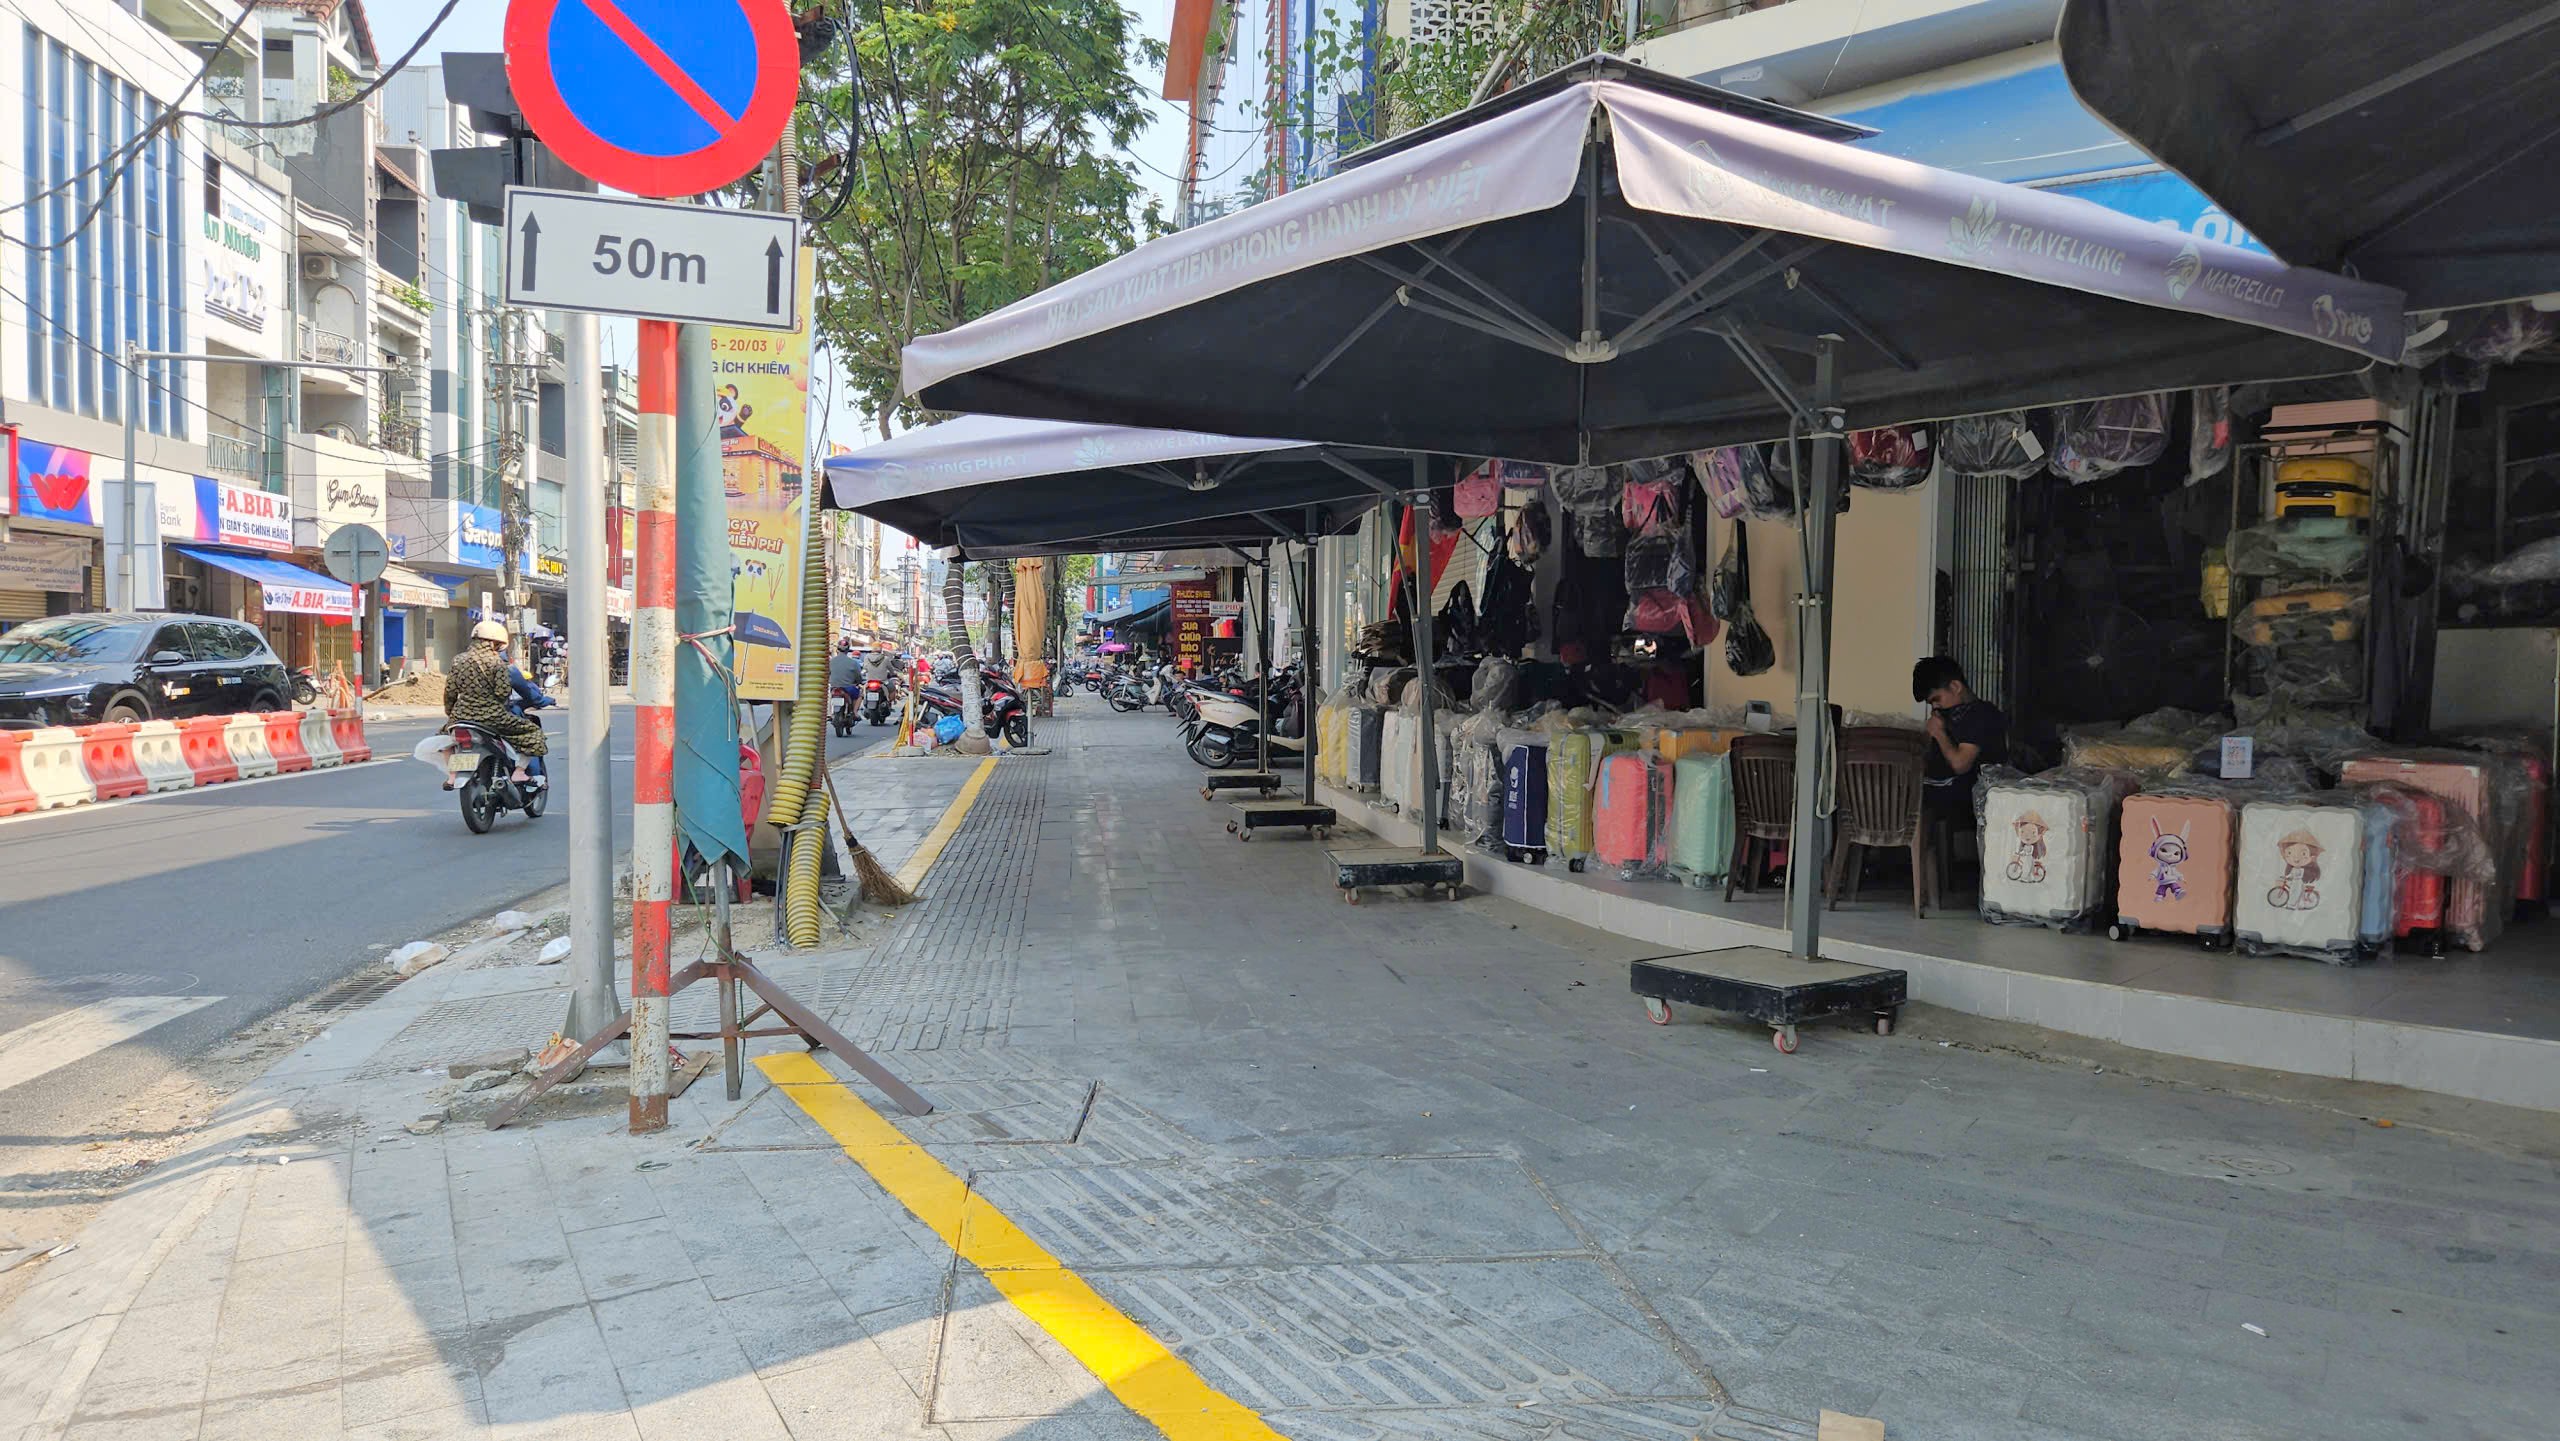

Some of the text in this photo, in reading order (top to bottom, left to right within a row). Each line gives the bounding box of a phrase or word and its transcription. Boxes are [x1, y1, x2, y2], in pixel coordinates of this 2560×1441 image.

[1219, 219, 1302, 274] PHONG
[1306, 199, 1379, 246] HÀNH
[1426, 159, 1493, 216] VIỆT
[592, 234, 706, 284] 50m
[2006, 223, 2127, 276] TRAVELKING
[2201, 268, 2286, 309] MARCELLO
[729, 338, 768, 352] 20/03
[747, 360, 790, 375] KHIÊM
[226, 489, 274, 519] A.BIA
[161, 513, 182, 527] Bank
[758, 537, 782, 553] PHÍ
[291, 591, 324, 609] A.BIA
